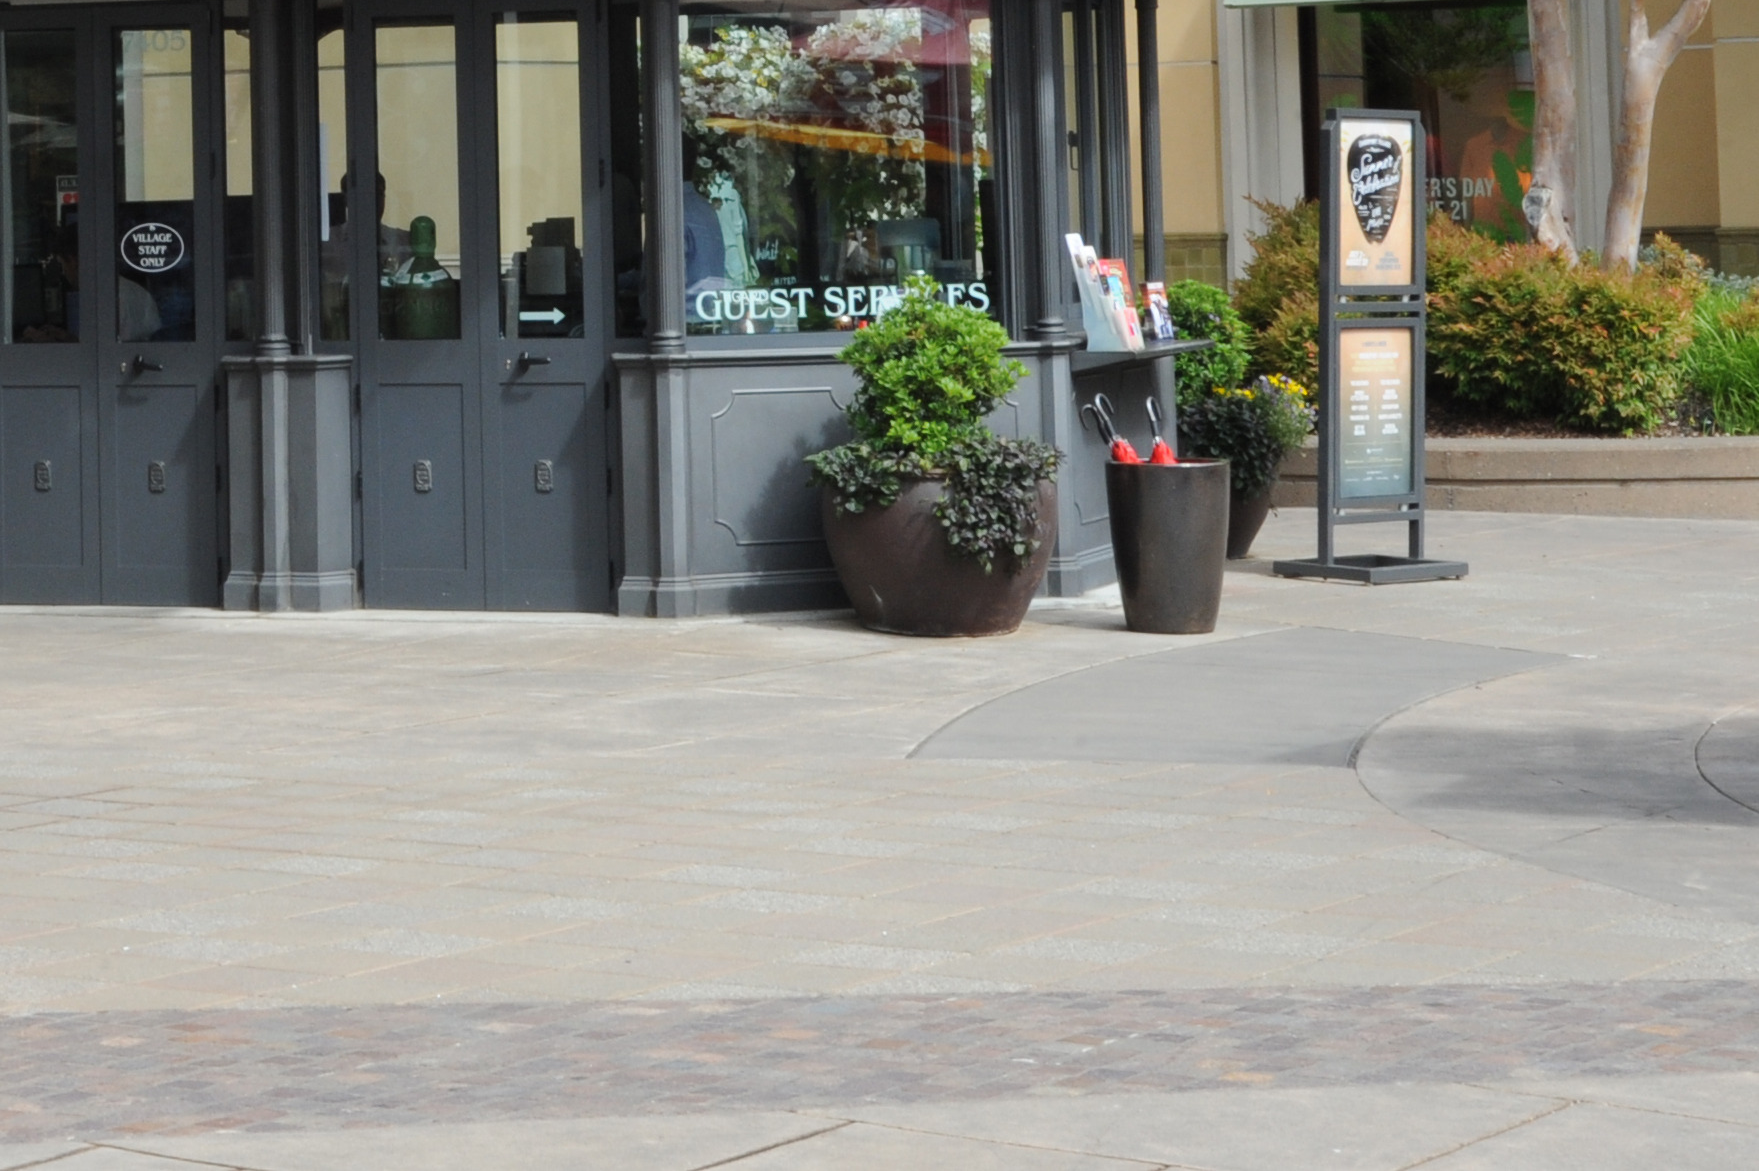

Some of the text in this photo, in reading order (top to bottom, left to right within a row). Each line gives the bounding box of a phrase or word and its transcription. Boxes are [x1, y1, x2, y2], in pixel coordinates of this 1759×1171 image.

[1462, 177, 1496, 198] DAY
[1450, 200, 1468, 221] 21
[132, 233, 172, 243] VILLAGE
[138, 245, 167, 255] STAFF
[140, 257, 166, 268] ONLY
[695, 287, 815, 321] GUEST
